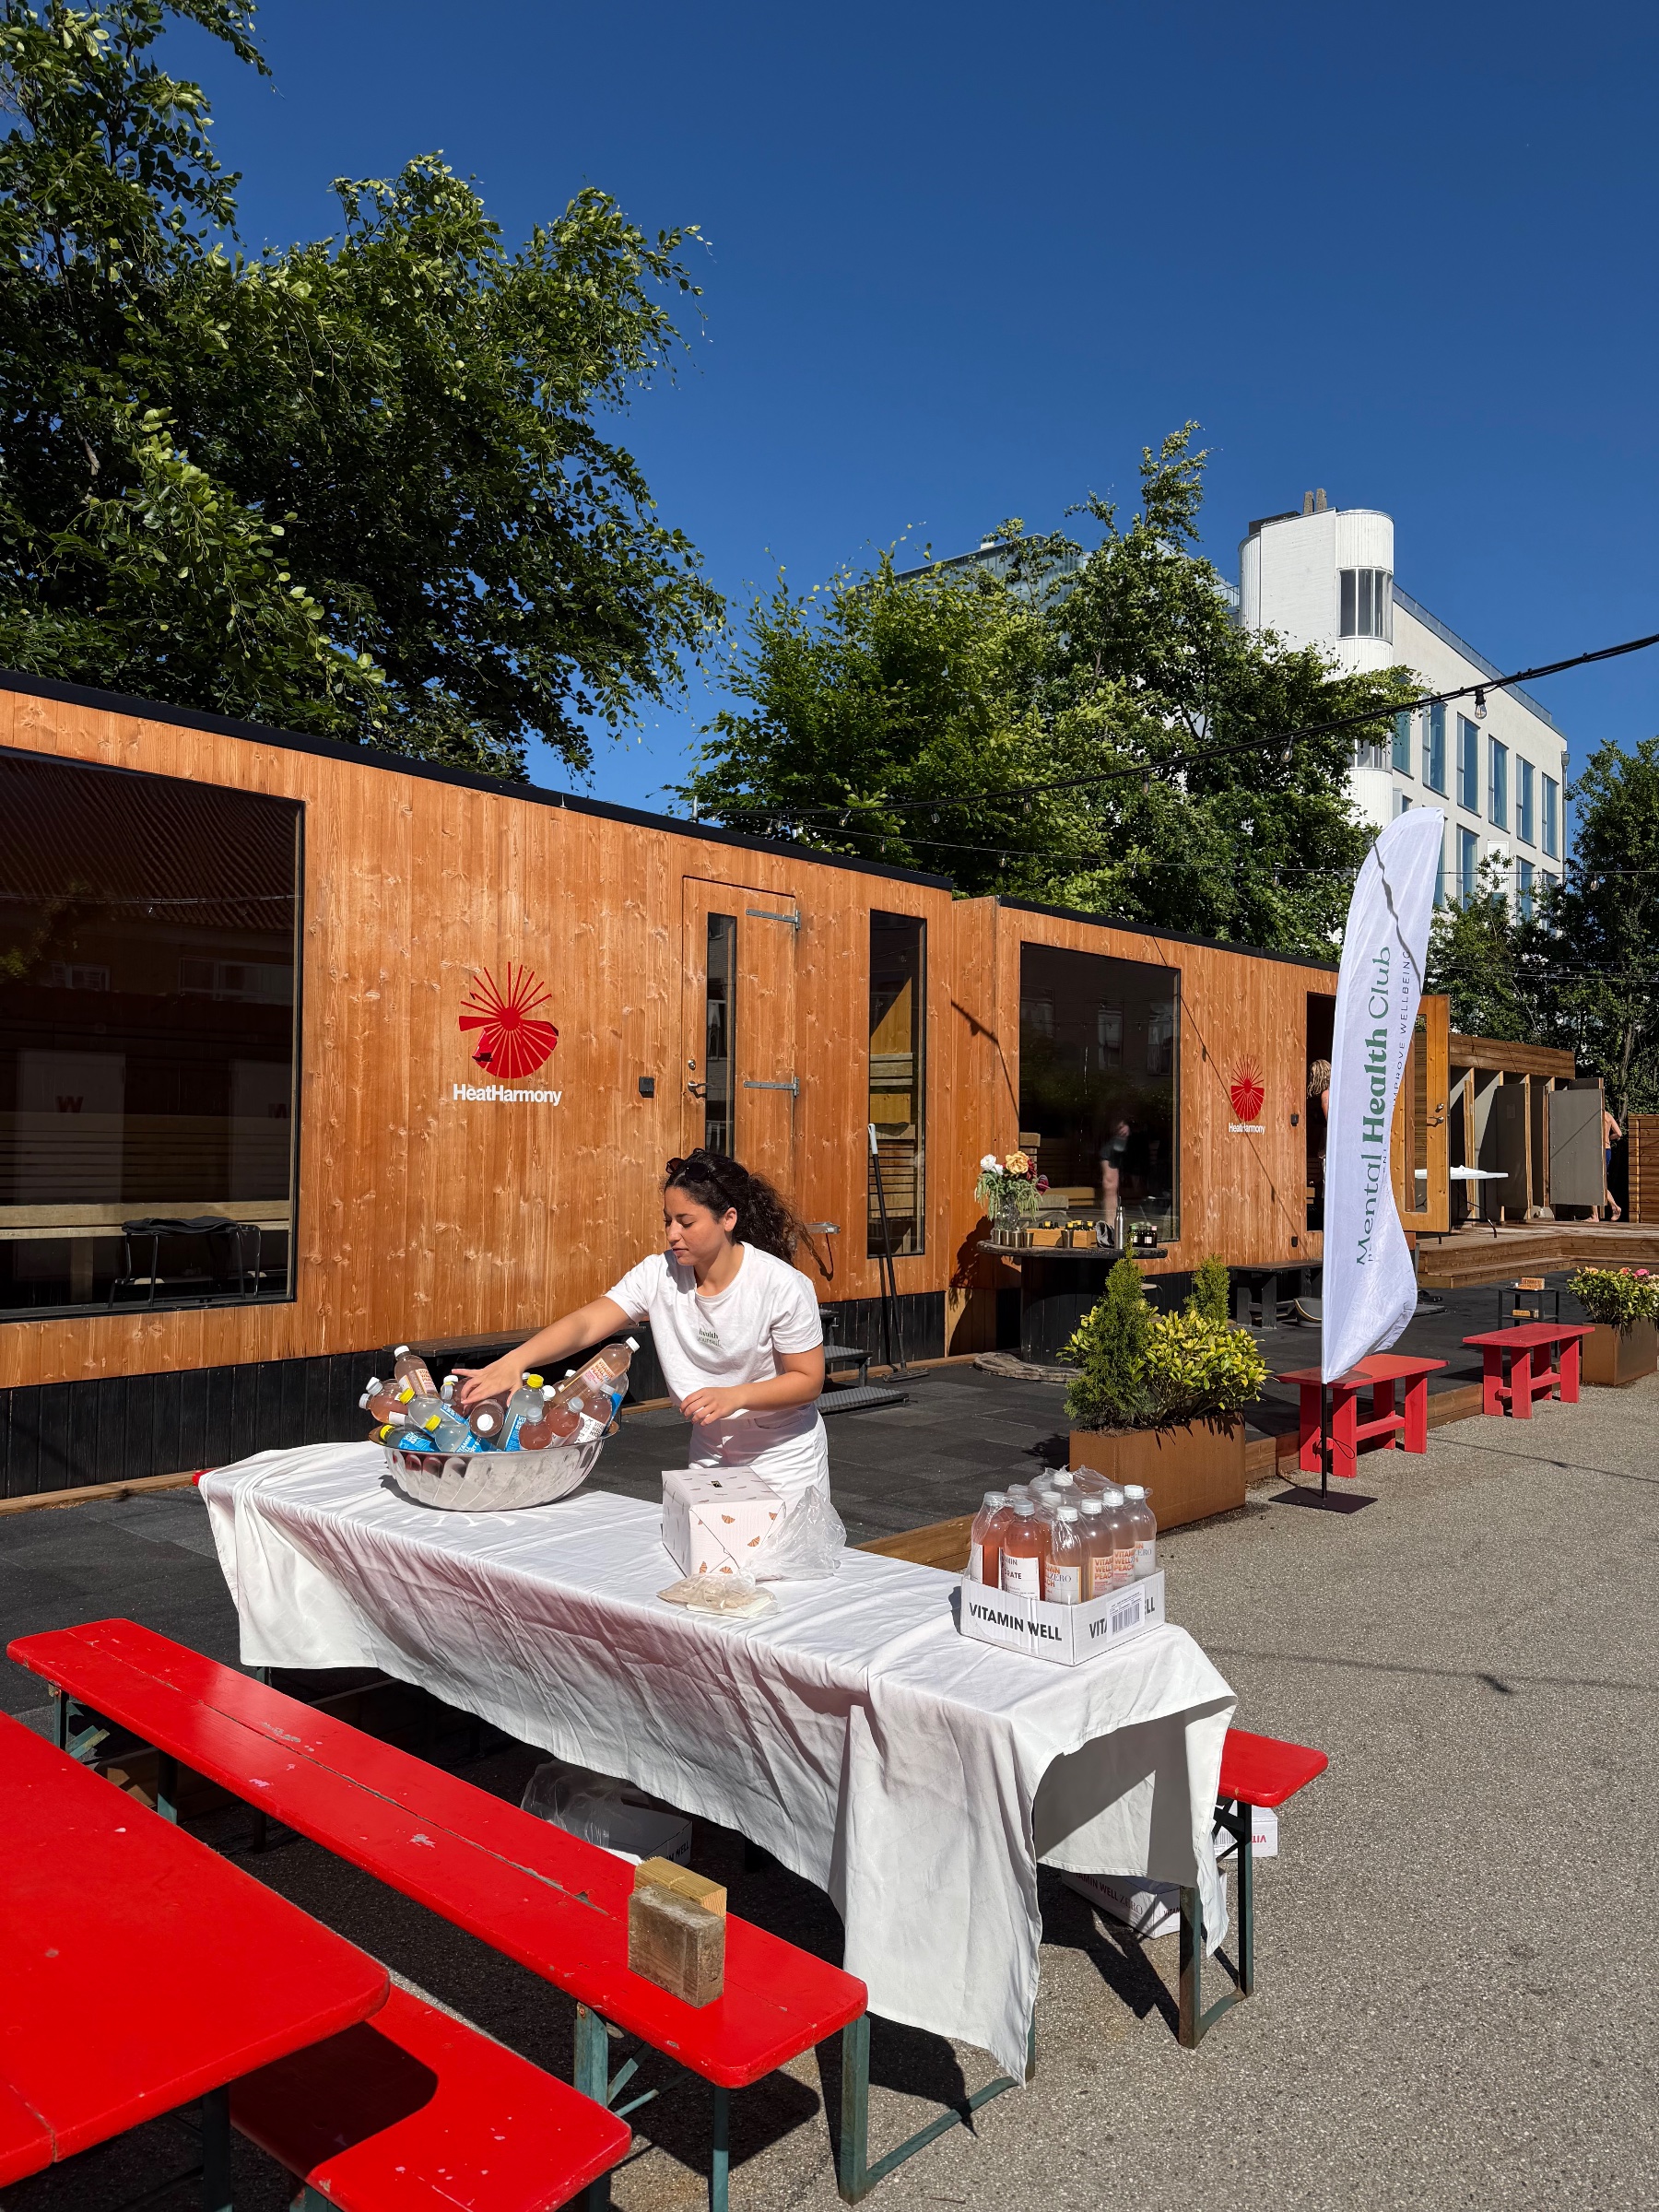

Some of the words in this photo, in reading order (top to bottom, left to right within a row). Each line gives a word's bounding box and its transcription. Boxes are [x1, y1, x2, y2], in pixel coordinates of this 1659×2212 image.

[1369, 947, 1390, 1018] Club
[1399, 951, 1411, 1033] WELLBEING
[453, 1083, 562, 1107] HeatHarmony
[1362, 1029, 1387, 1144] Health
[1228, 1122, 1265, 1135] HeatHarmony
[1357, 1154, 1382, 1265] Mental
[969, 1602, 1024, 1632] VITAMIN
[1027, 1620, 1063, 1641] WELL
[1100, 1882, 1118, 1900] WELL
